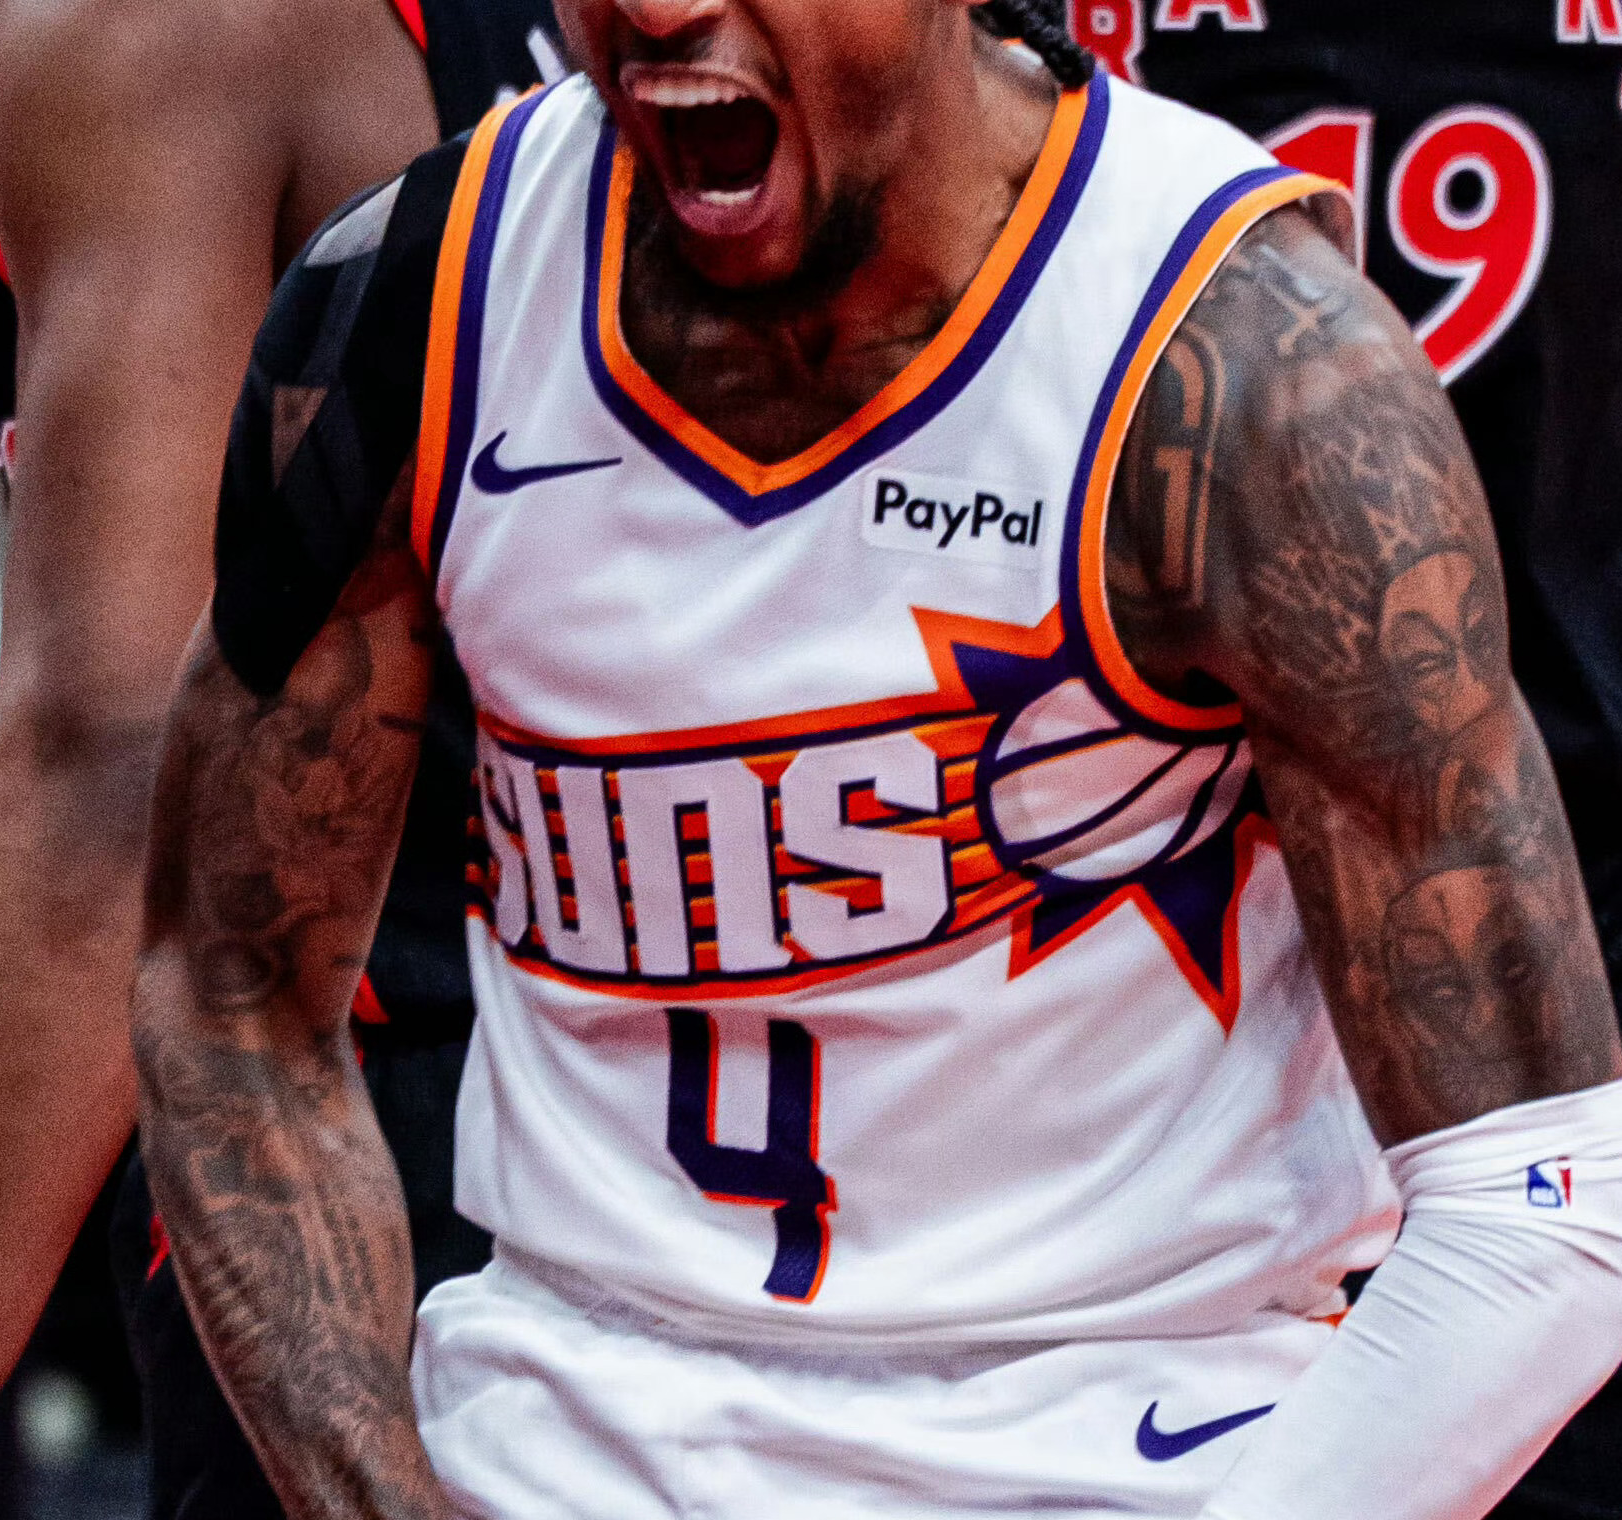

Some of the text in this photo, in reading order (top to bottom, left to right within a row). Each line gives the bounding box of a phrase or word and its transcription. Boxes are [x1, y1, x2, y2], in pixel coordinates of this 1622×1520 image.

[873, 478, 1044, 549] PayPal
[477, 731, 951, 978] SUNS
[665, 1005, 838, 1304] 4
